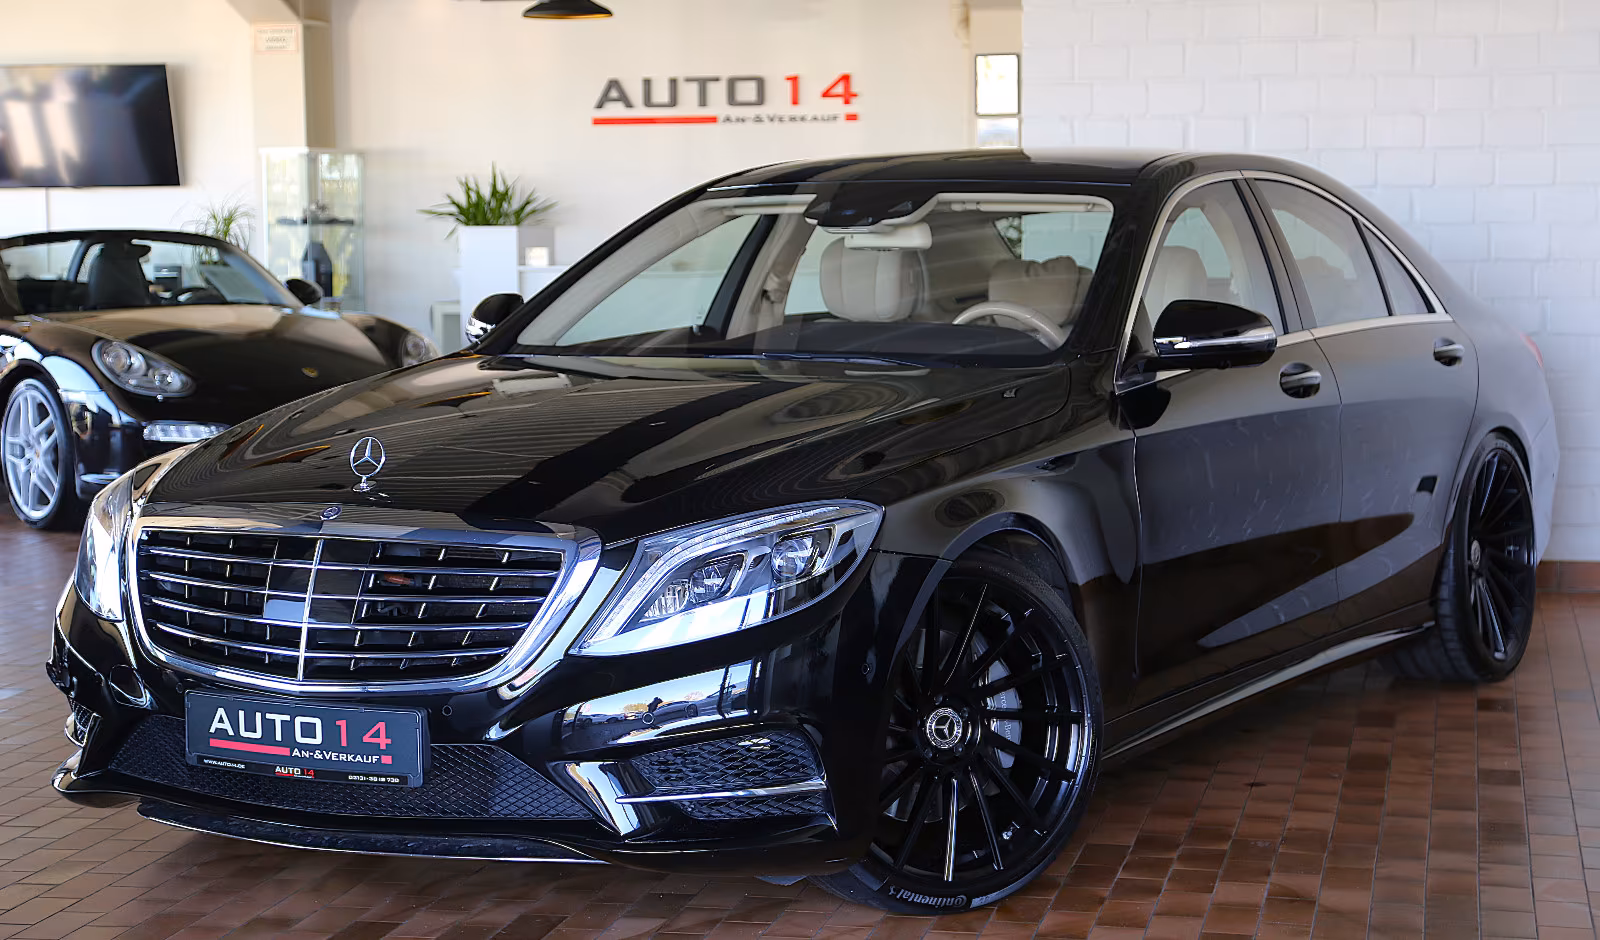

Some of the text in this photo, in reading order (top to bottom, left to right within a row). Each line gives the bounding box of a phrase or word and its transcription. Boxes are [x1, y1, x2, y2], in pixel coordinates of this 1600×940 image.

[594, 73, 859, 109] AUTO 14
[209, 707, 392, 750] AUTO 14
[275, 766, 301, 775] AUTO
[304, 768, 315, 778] 14
[896, 888, 967, 908] Continental
